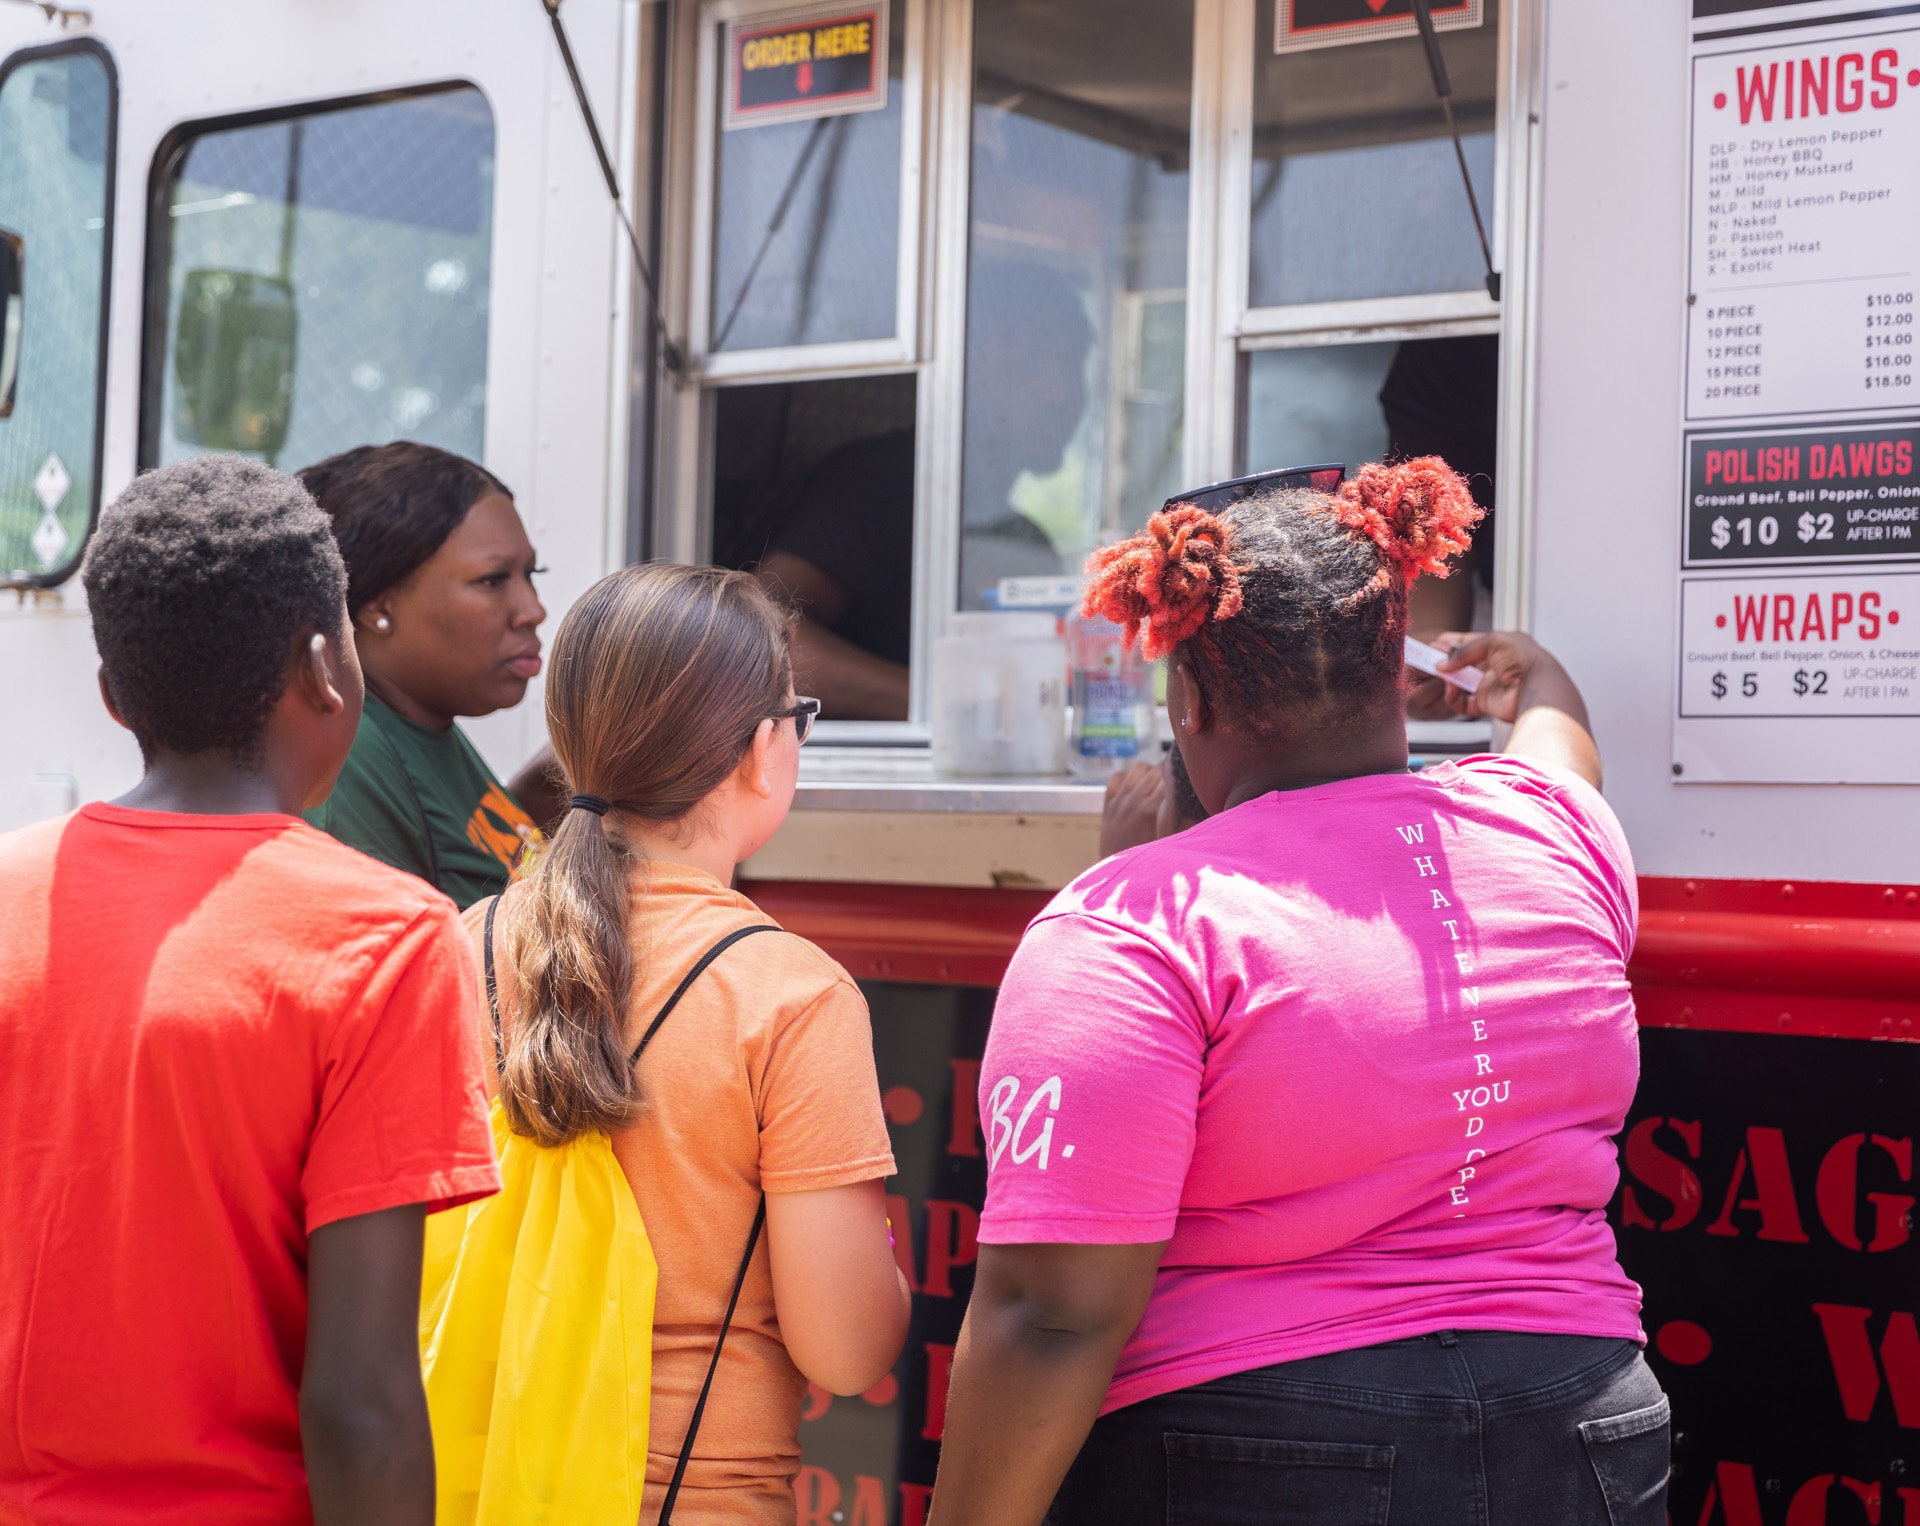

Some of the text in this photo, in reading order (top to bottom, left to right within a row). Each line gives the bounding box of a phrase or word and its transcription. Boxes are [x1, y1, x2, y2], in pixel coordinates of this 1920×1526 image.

[743, 22, 870, 71] ORDER HERE
[1737, 48, 1898, 125] WINGS
[1710, 142, 1737, 157] DLP
[1751, 138, 1774, 153] Dry
[1779, 133, 1827, 149] Lemon
[1832, 127, 1883, 144] Pepper
[1710, 158, 1729, 171] HB
[1744, 152, 1788, 168] Honey
[1793, 148, 1823, 162] BBQ
[1710, 172, 1732, 186] HM
[1746, 167, 1790, 183] Honey
[1795, 161, 1853, 177] Mustard
[1710, 189, 1720, 200] M
[1735, 185, 1765, 198] Mild
[1709, 203, 1738, 215] MLP
[1752, 198, 1781, 212] Mild
[1787, 193, 1835, 208] Lemon
[1840, 187, 1892, 204] Pepper
[1709, 220, 1719, 230] N
[1732, 214, 1777, 228] Naked
[1731, 229, 1784, 243] Passion
[1708, 249, 1726, 261] SH
[1741, 244, 1783, 258] Sweet
[1788, 240, 1822, 253] Heat
[1708, 265, 1717, 276] X
[1731, 261, 1774, 274] Exotic
[1866, 293, 1914, 308] $10.00
[1707, 305, 1755, 319] 8 PIECE
[1866, 313, 1913, 328] $12.00
[1707, 324, 1763, 339] 10 PIECE
[1866, 333, 1912, 349] $14.00
[1707, 344, 1762, 359] 12 PIECE
[1865, 354, 1912, 369] $16.00
[1707, 364, 1761, 379] 15 PIECE
[1865, 374, 1912, 389] $18.50
[1705, 384, 1761, 399] 20 PIECE
[1705, 440, 1913, 485] POLISH DAWGS
[1695, 492, 1745, 507] Ground
[1749, 489, 1784, 505] Beef,
[1788, 489, 1815, 503] Bell
[1819, 488, 1874, 504] Pepper,
[1846, 507, 1919, 522] UP-CHARGE
[1797, 511, 1834, 543] $2
[1846, 526, 1884, 541] AFTER
[1893, 525, 1911, 539] PM
[1734, 592, 1880, 642] WRAPS
[1687, 651, 1728, 663] Ground
[1760, 651, 1781, 661] Bell
[1879, 649, 1920, 660] Cheese
[1843, 666, 1918, 681] UP-CHARGE
[1793, 668, 1829, 697] $2
[1843, 686, 1880, 699] AFTER
[1891, 685, 1909, 698] PM
[1452, 1080, 1511, 1112] YOU
